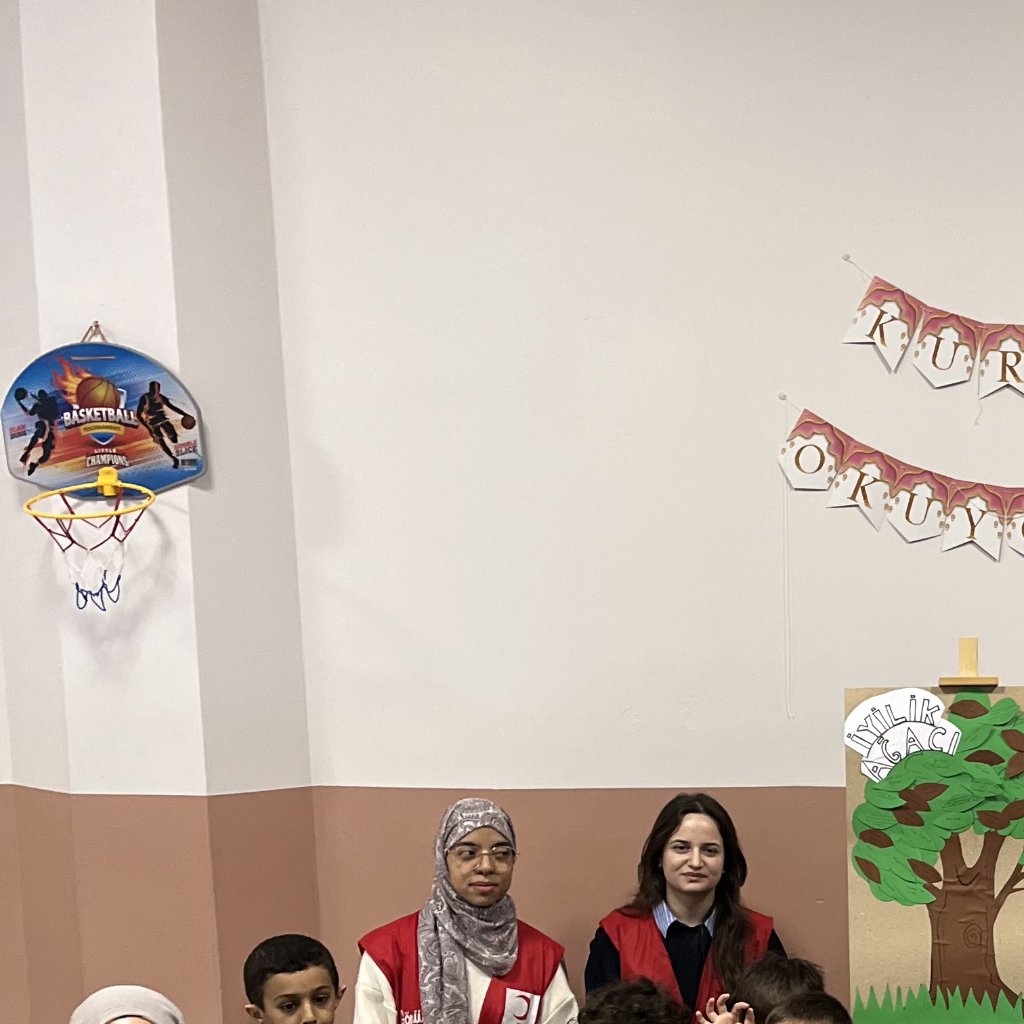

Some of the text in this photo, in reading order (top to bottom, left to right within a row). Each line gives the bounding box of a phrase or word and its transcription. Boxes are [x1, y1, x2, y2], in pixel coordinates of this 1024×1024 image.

[63, 407, 138, 428] BASKETBALL
[86, 454, 129, 467] CHAMPIONS
[846, 694, 940, 751] İYİLİK
